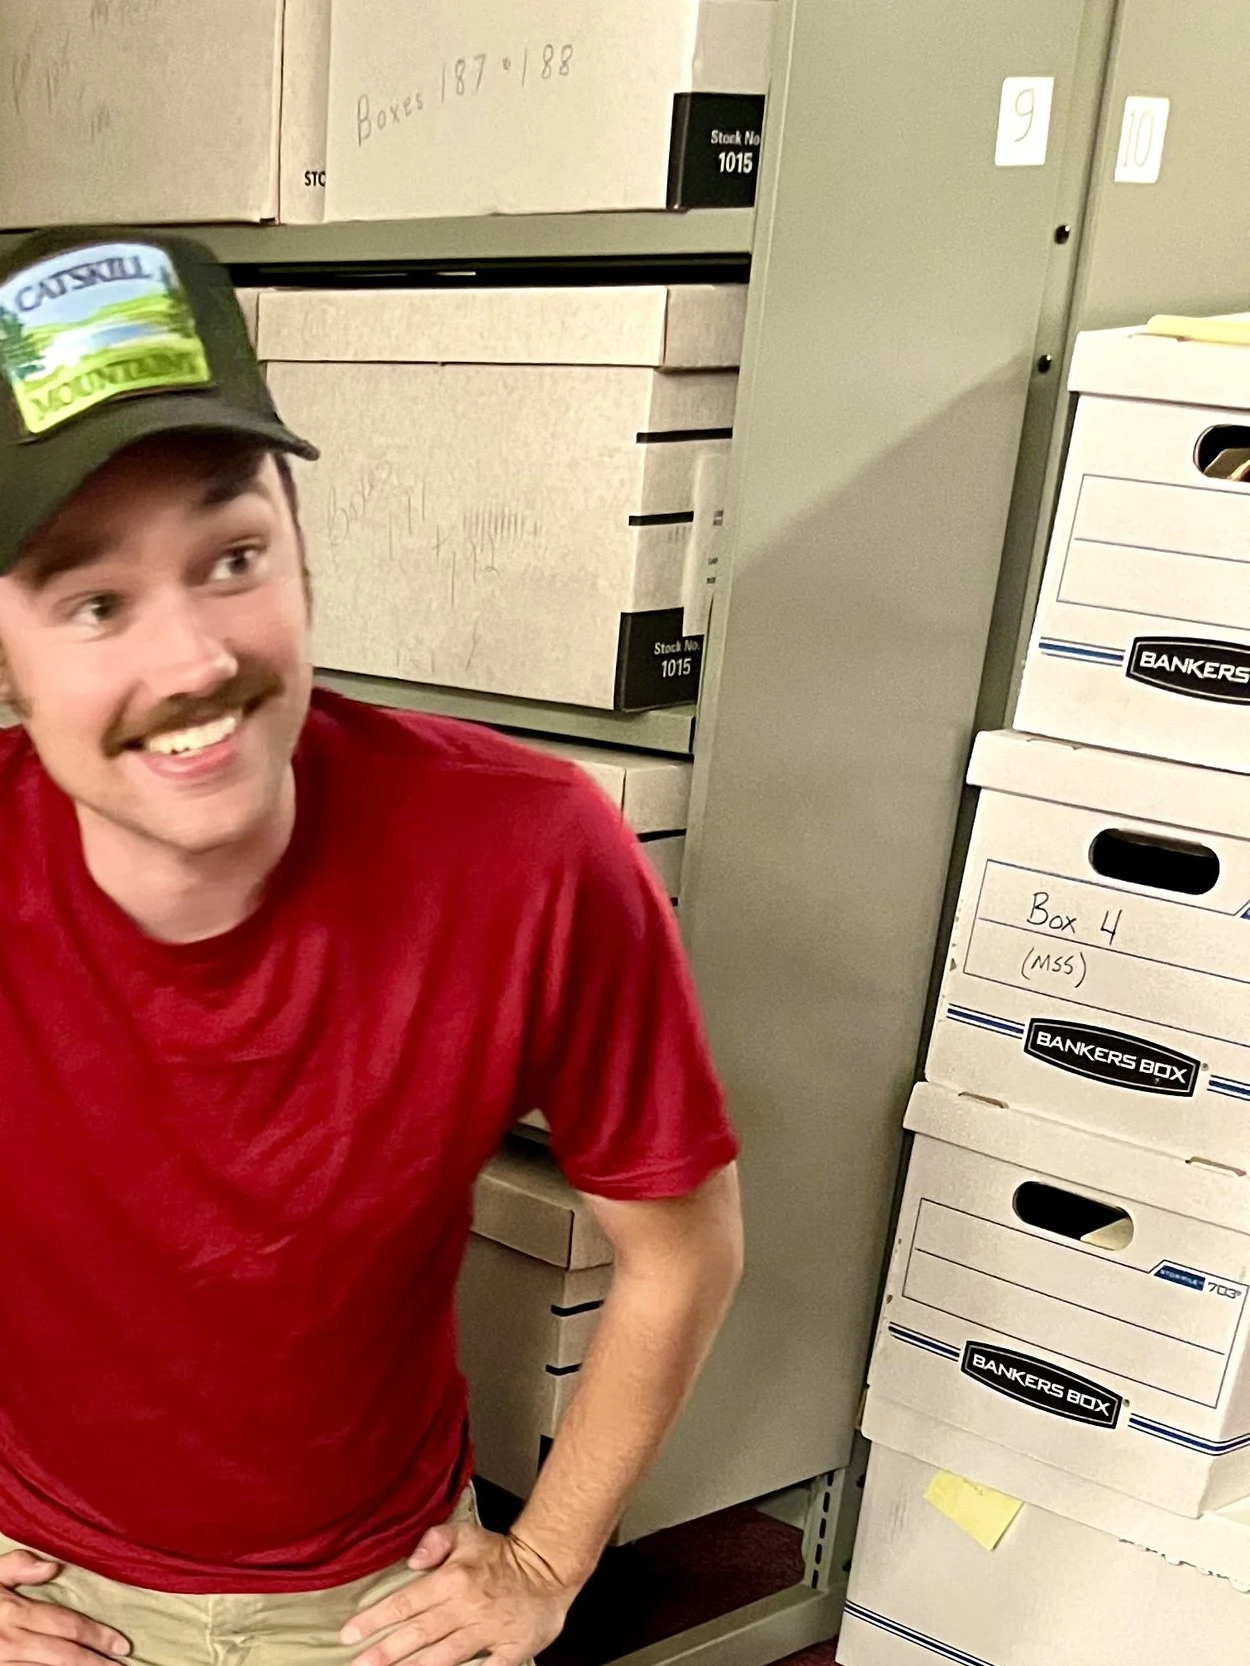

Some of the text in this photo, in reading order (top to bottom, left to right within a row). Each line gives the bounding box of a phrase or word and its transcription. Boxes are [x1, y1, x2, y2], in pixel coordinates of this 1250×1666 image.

[357, 92, 424, 147] Boxes
[439, 53, 487, 103] 187
[521, 44, 575, 88] 188
[1013, 88, 1035, 143] 9
[710, 129, 742, 145] Stock
[718, 151, 754, 174] 1015
[1123, 108, 1155, 168] 10
[13, 254, 155, 314] CATSKILL
[28, 350, 196, 421] MOUNTAINS
[653, 641, 682, 656] Stock
[660, 657, 692, 678] 1015
[1139, 651, 1250, 684] BANKERS
[1026, 891, 1124, 945] Box 4
[1021, 947, 1087, 988] (MSS)
[1036, 1031, 1188, 1084] BANKERS BOX
[972, 1353, 1112, 1416] BANKERS BOX
